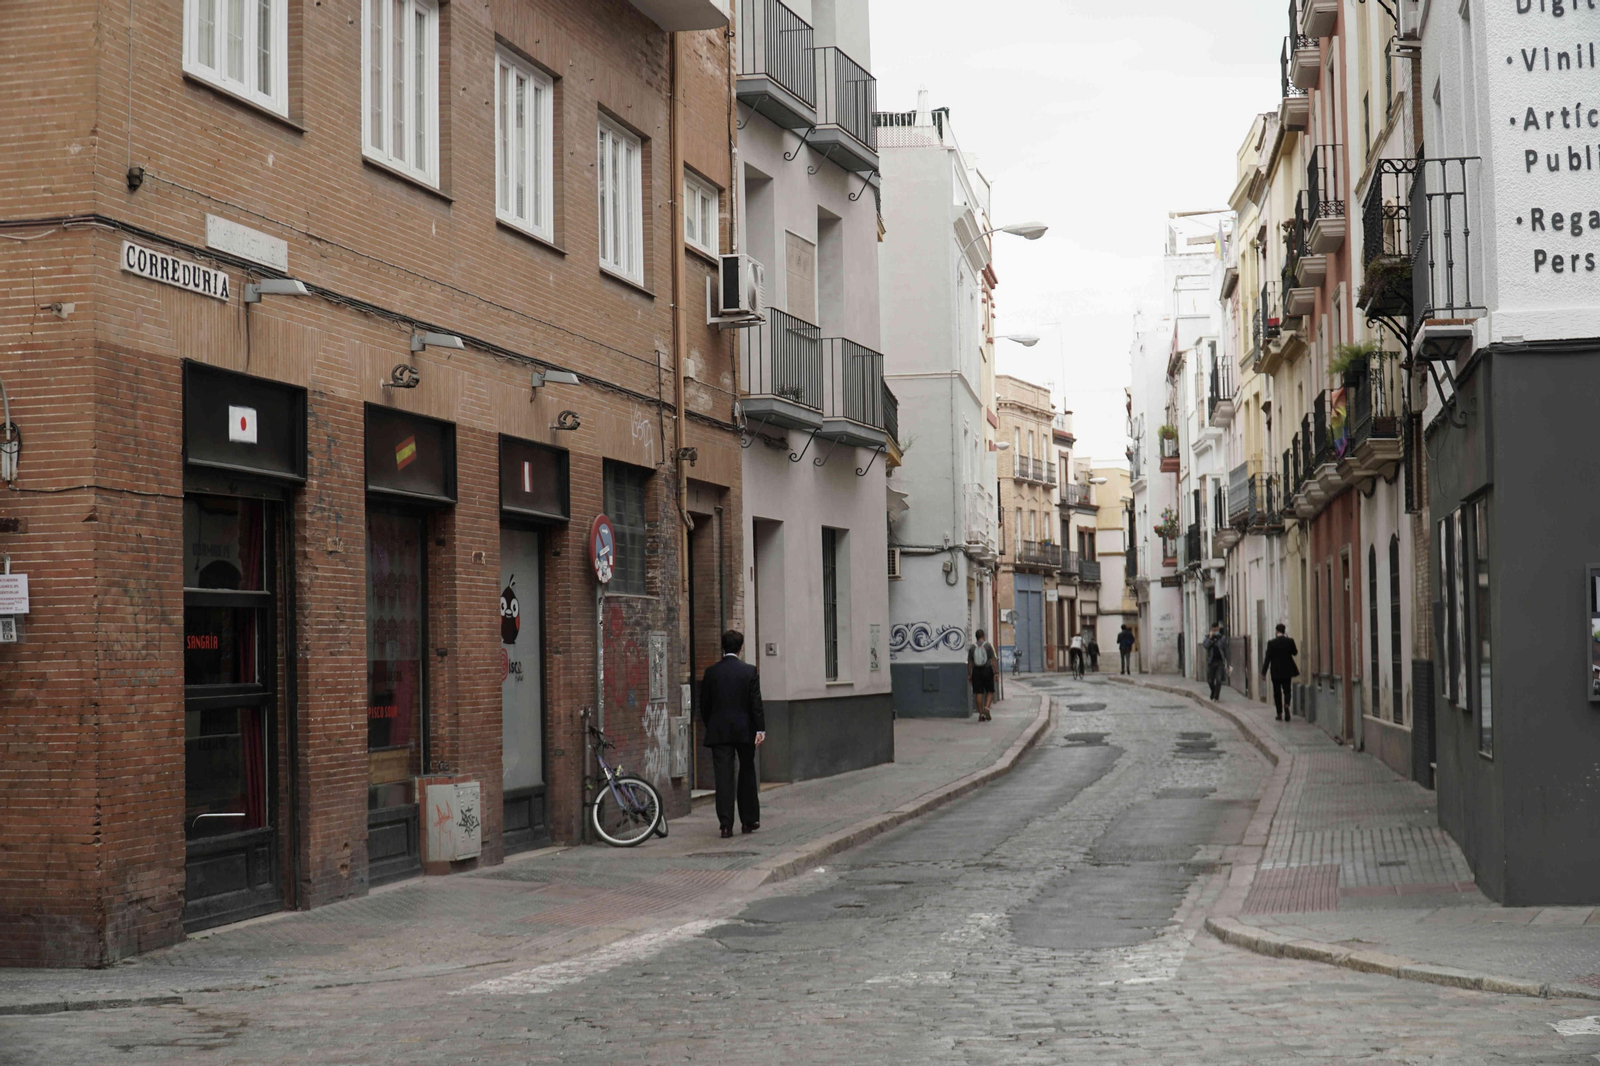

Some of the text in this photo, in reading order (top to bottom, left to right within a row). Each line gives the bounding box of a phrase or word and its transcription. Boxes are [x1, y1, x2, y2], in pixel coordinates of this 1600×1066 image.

[1521, 42, 1595, 71] Vinil
[1523, 102, 1599, 131] Artíc
[1530, 207, 1600, 236] Rega
[126, 245, 229, 298] CORREDURIA
[1534, 249, 1596, 273] Pers
